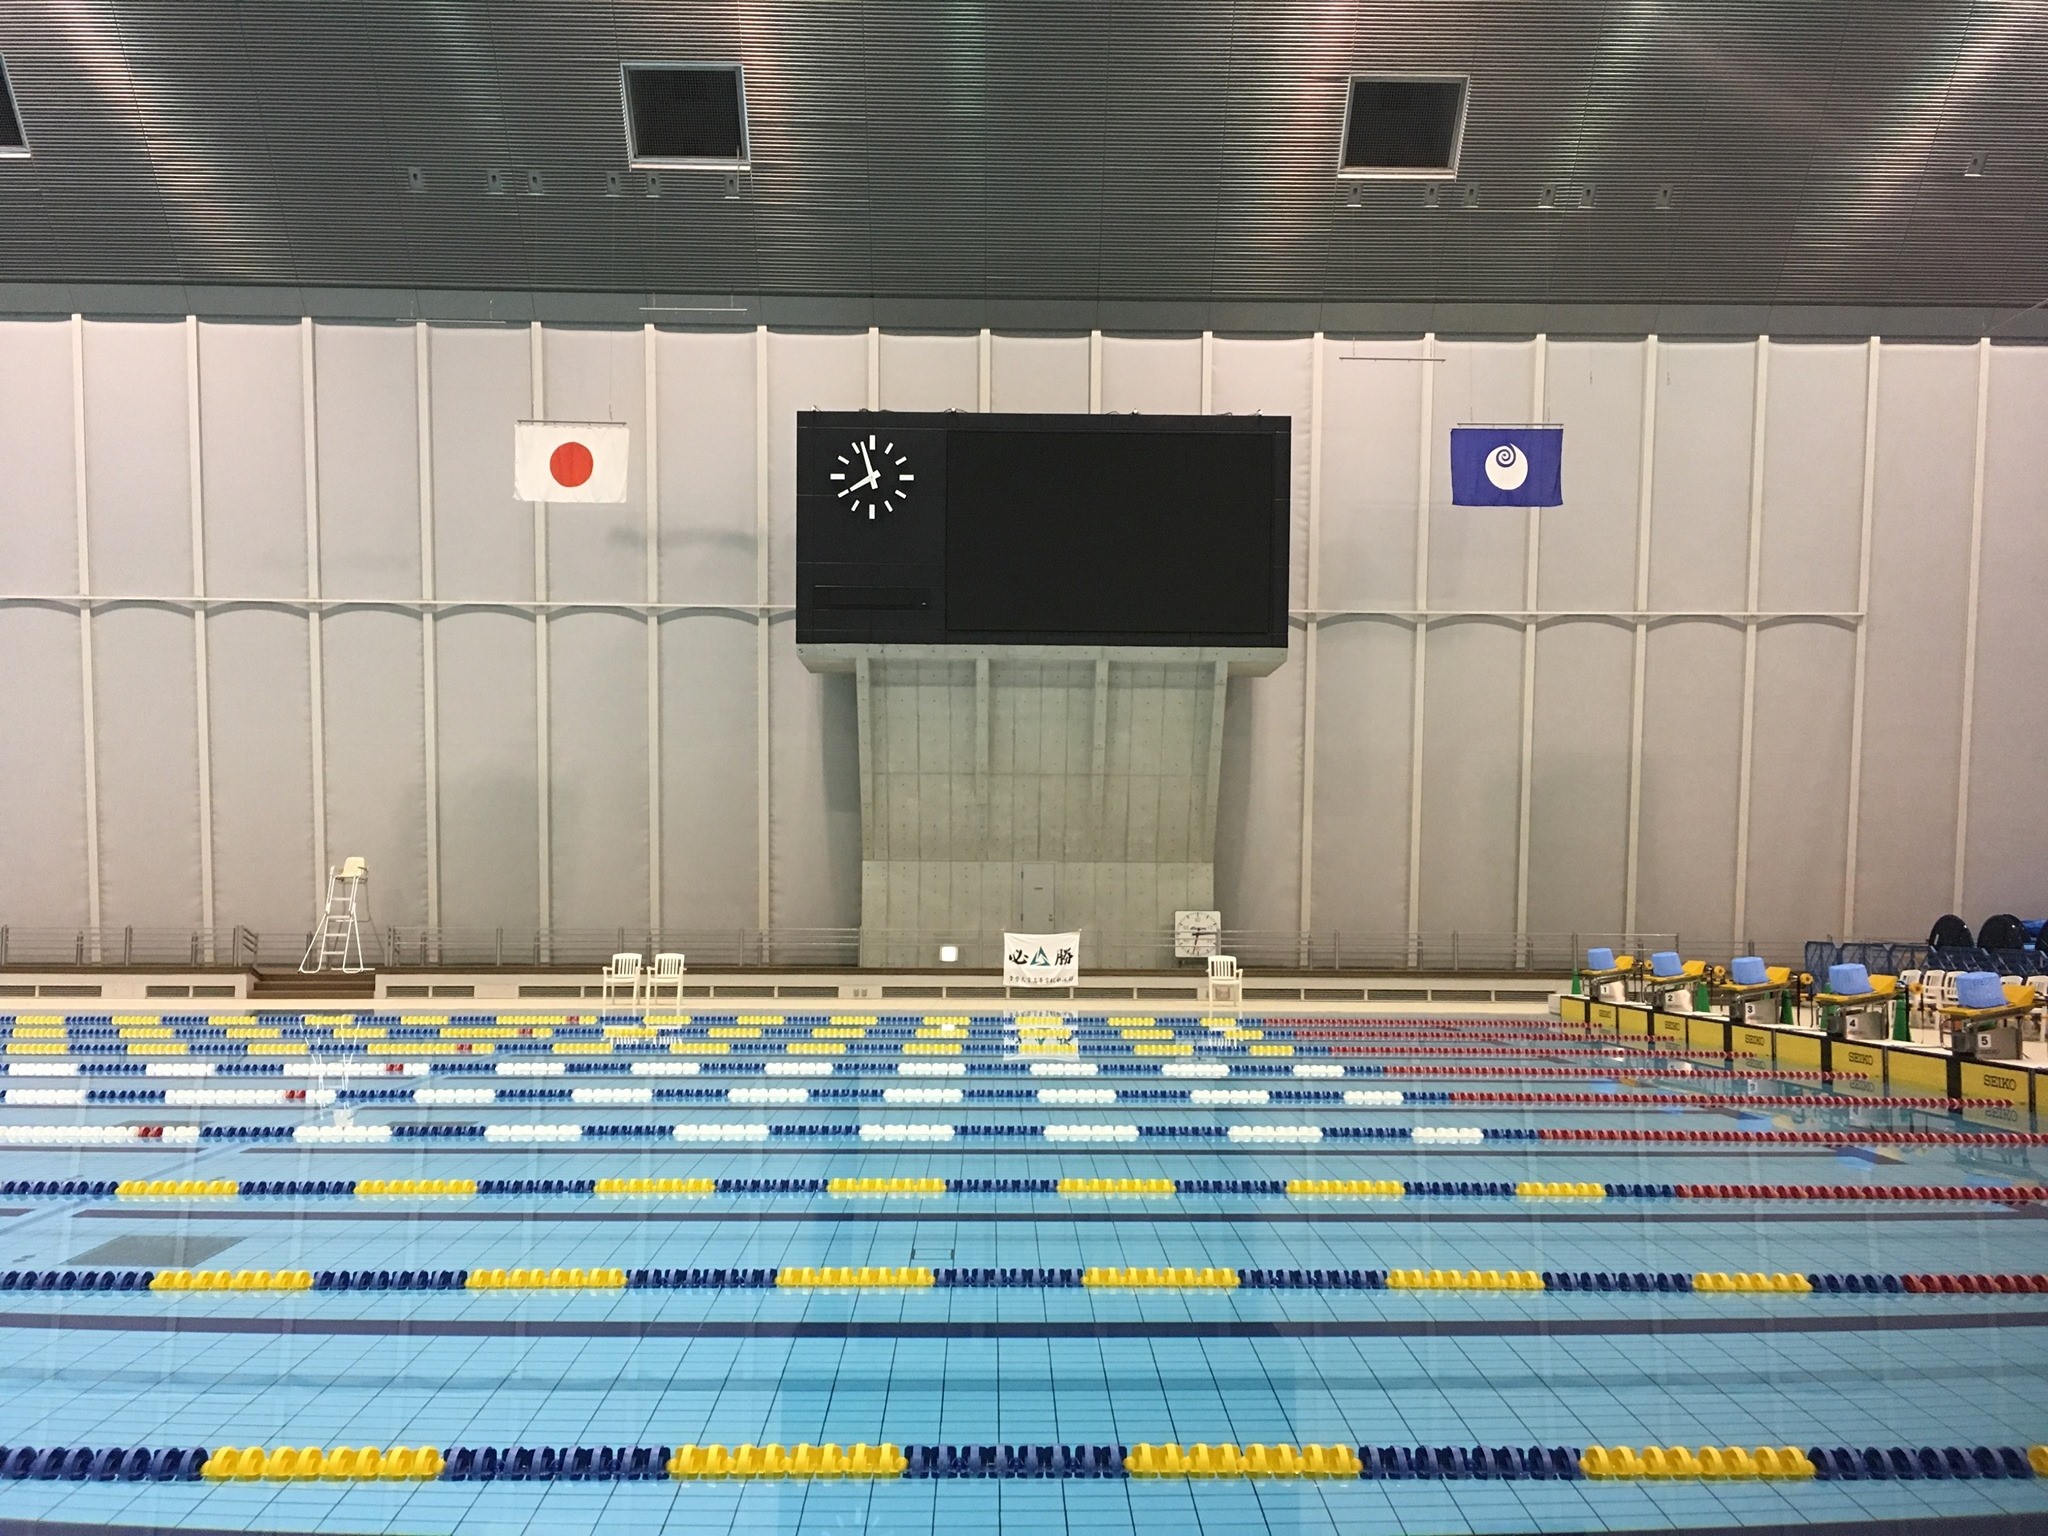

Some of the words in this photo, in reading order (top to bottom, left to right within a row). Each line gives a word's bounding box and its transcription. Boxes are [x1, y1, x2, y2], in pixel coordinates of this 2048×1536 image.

[1747, 1005, 1753, 1013] 3
[1849, 1019, 1856, 1027] 4
[1981, 1036, 1988, 1045] 5
[1849, 1052, 1873, 1065] SEIKO
[1984, 1075, 2016, 1090] SEIKO
